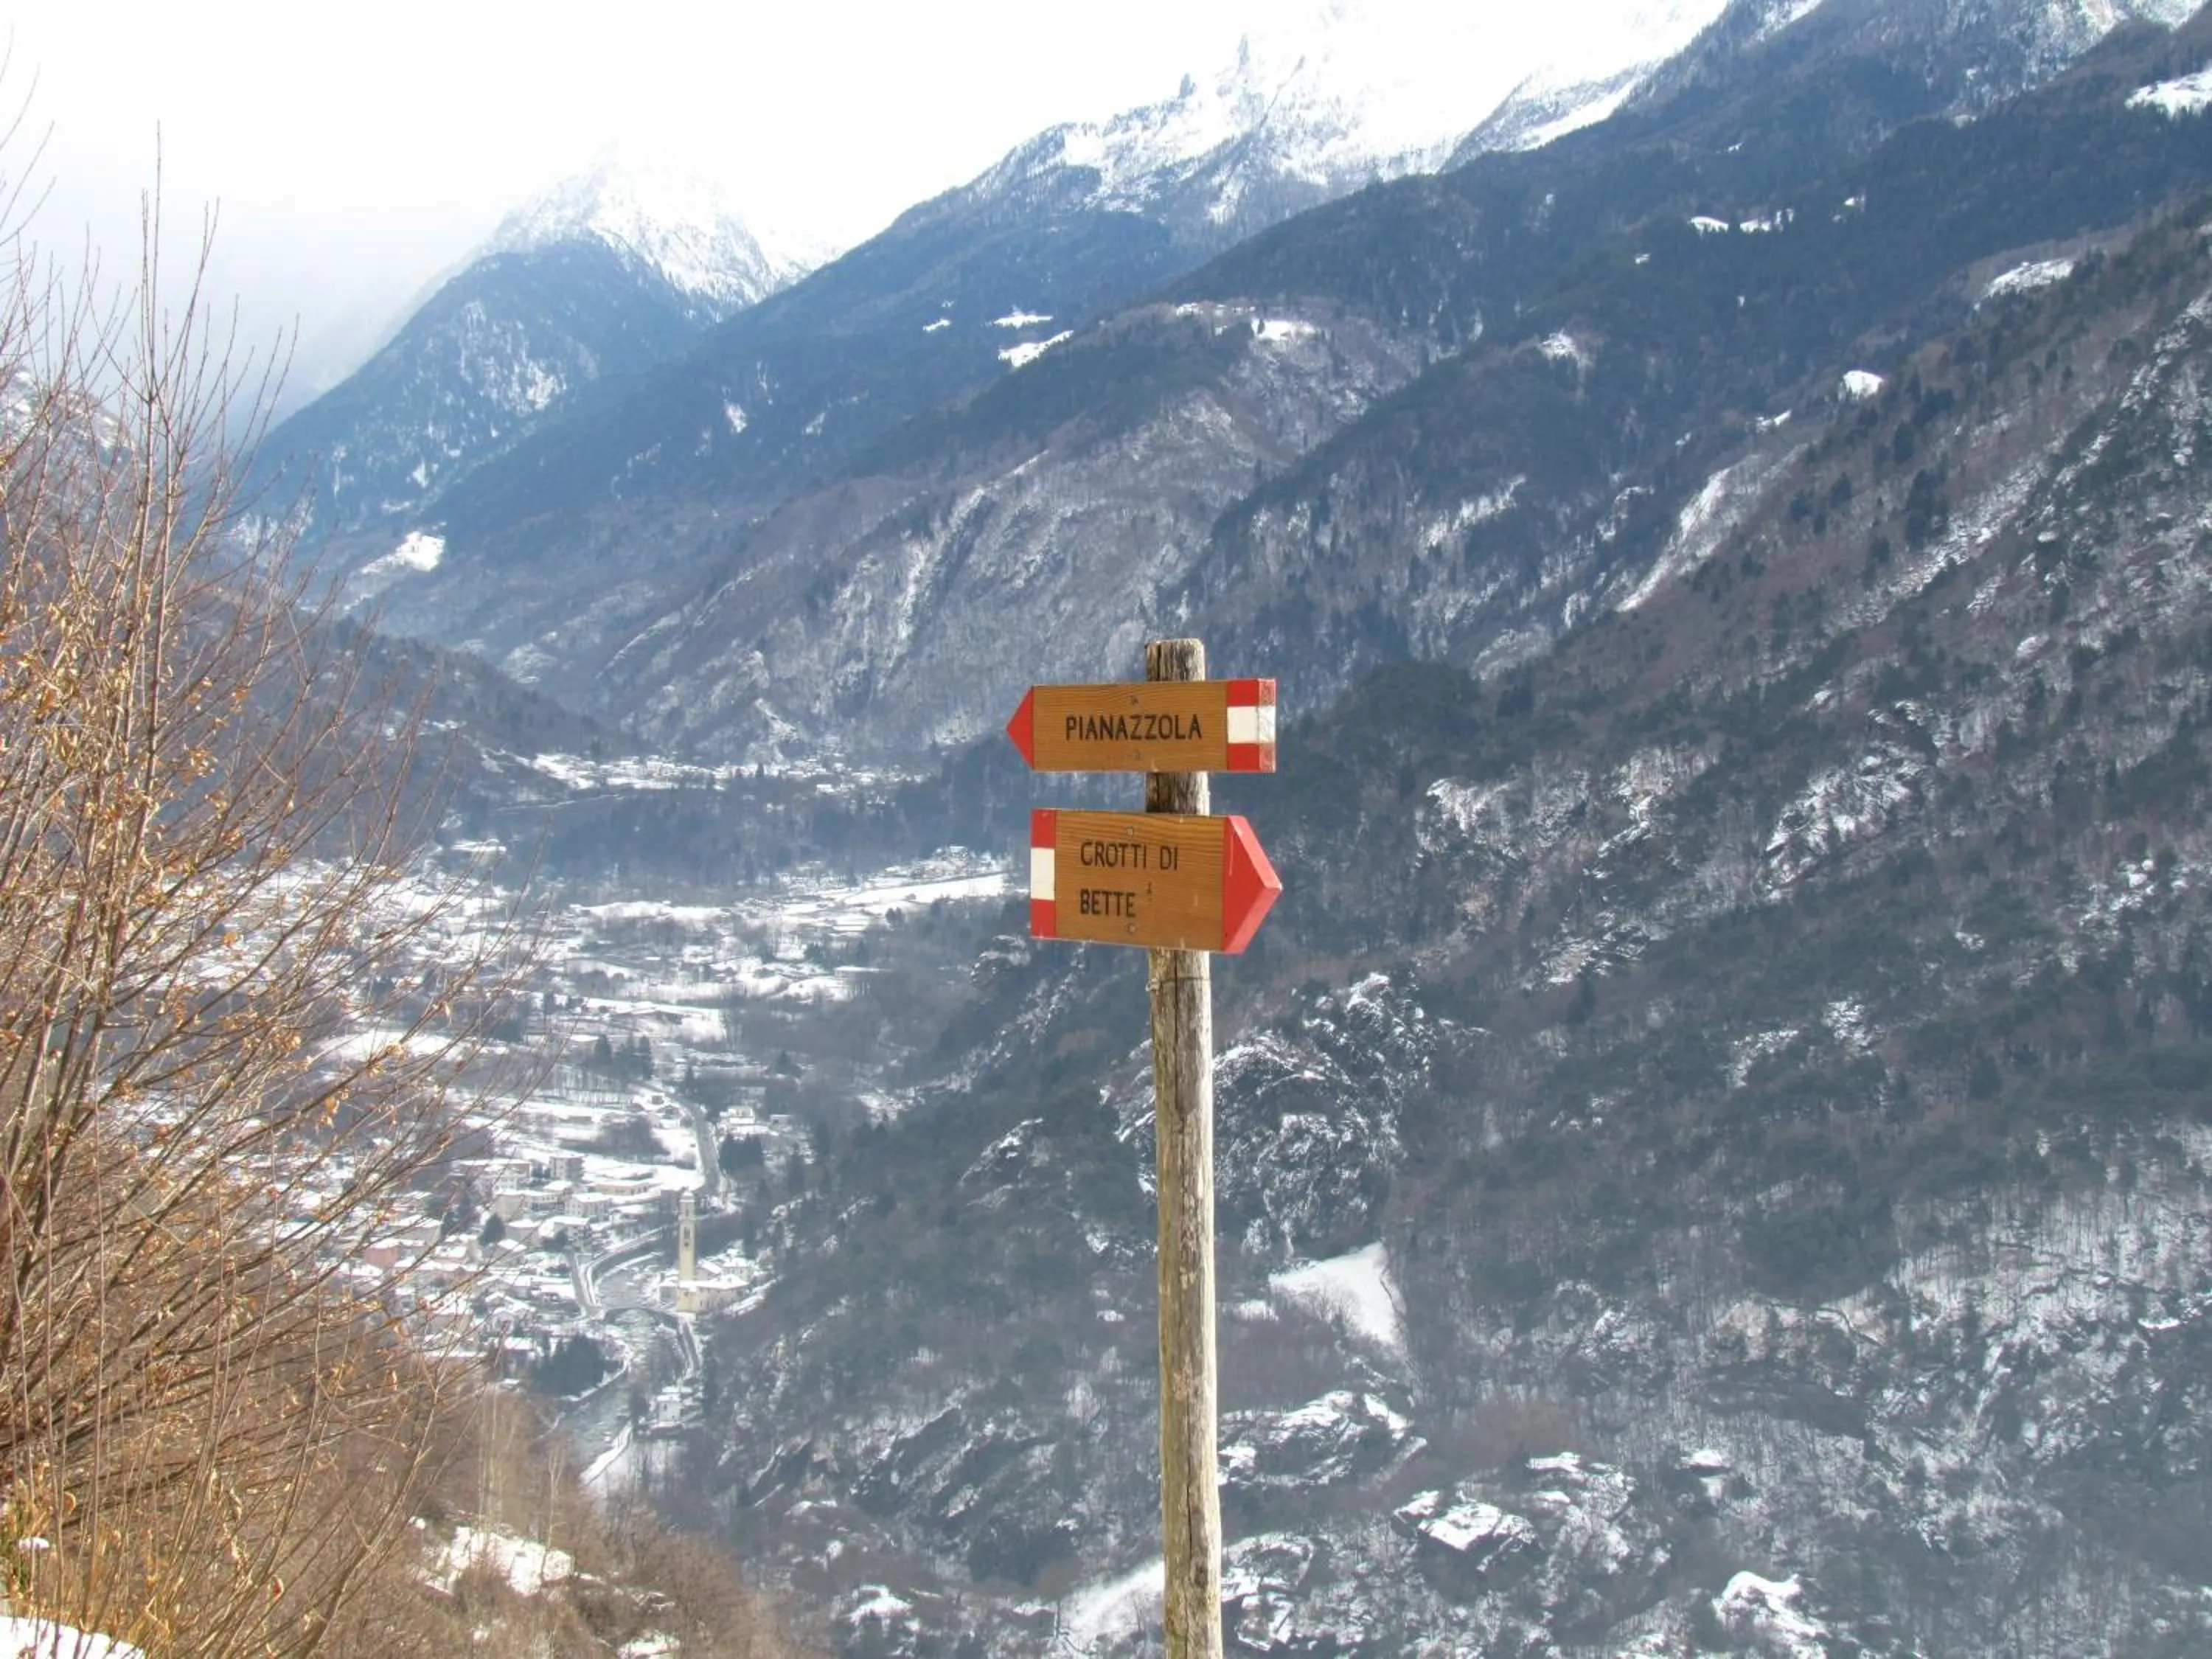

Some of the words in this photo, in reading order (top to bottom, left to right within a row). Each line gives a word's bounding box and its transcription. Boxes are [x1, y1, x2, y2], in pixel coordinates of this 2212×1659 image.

[1065, 714, 1203, 741] PIANAZZOLA
[1159, 846, 1178, 871] DI
[1079, 888, 1136, 918] BETTE
